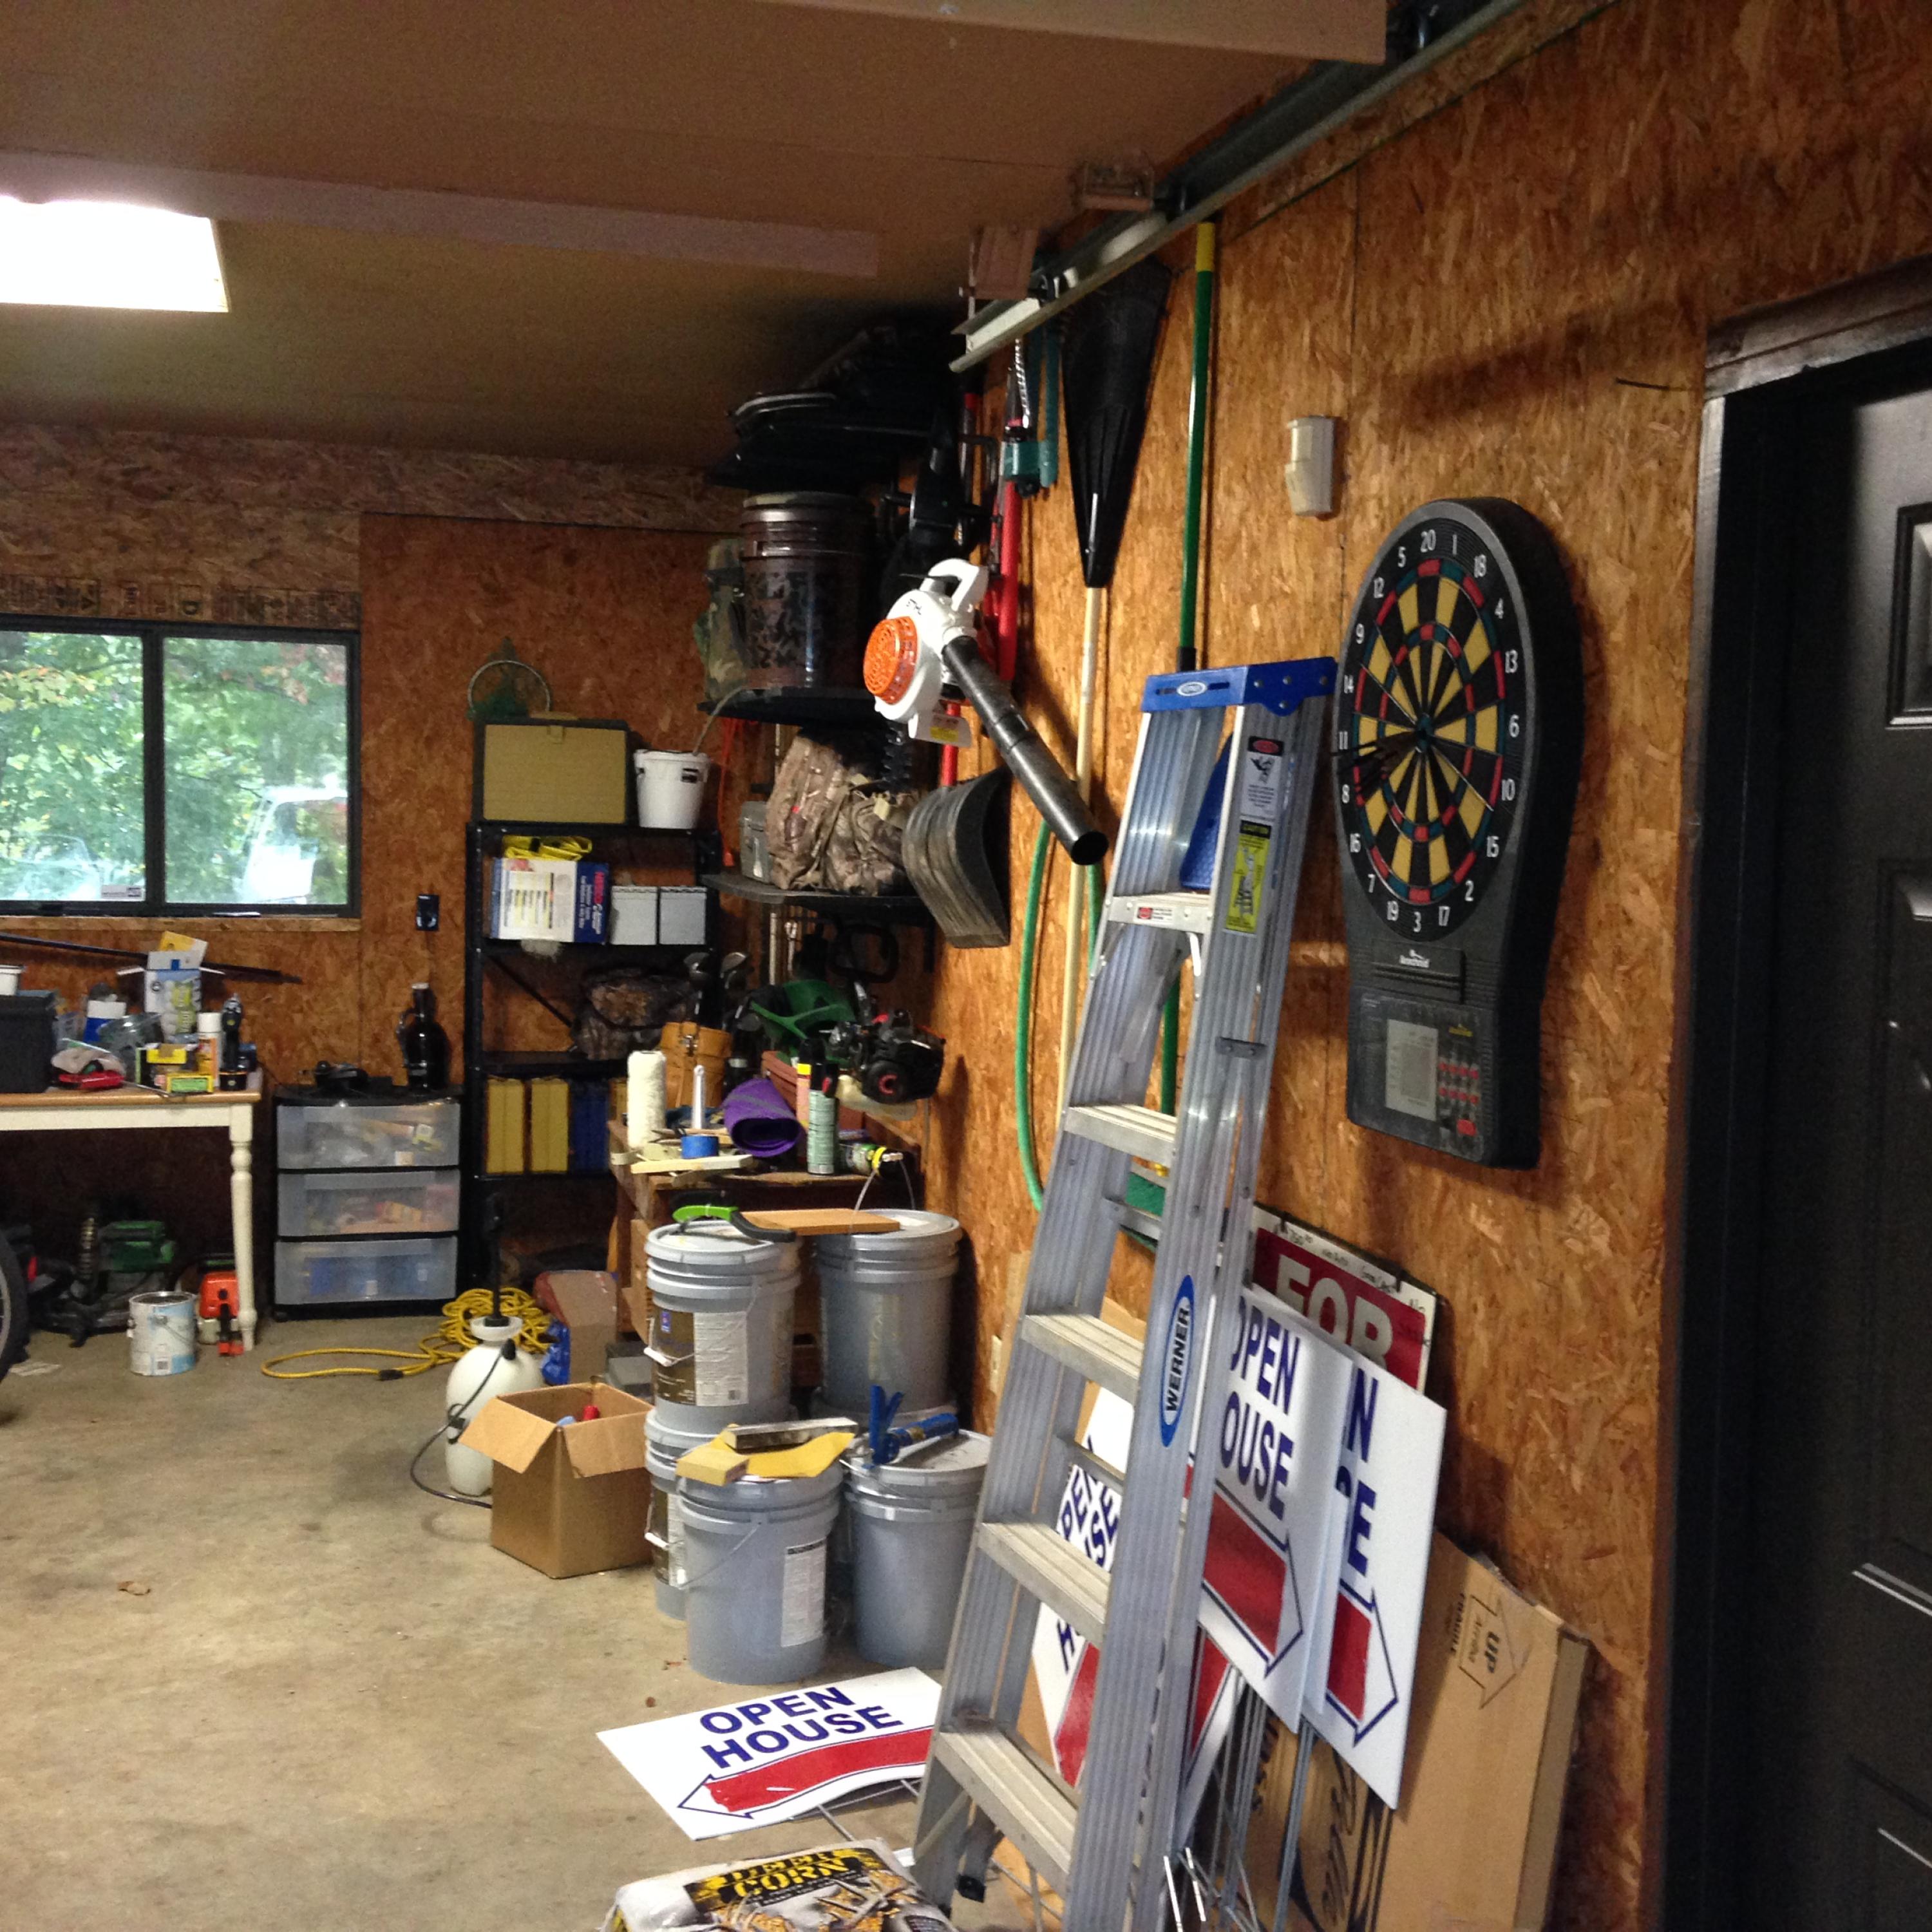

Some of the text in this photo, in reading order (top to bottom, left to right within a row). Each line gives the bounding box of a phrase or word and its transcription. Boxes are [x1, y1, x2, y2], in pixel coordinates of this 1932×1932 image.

[1421, 529, 1437, 553] 20
[1452, 535, 1457, 554] 1
[1397, 547, 1406, 567] 5
[1473, 554, 1487, 578] 18
[1374, 578, 1384, 598] 12
[1495, 599, 1504, 619] 4
[1356, 623, 1365, 643] 9
[1505, 649, 1518, 673] 13
[1343, 675, 1354, 694] 14
[1509, 715, 1520, 737] 6
[1339, 732, 1348, 750] 11
[1341, 784, 1350, 803] 8
[1501, 779, 1516, 800] 10
[1350, 833, 1361, 853] 16
[1486, 835, 1499, 857] 15
[1367, 874, 1376, 893] 7
[1465, 880, 1473, 902] 2
[1387, 902, 1399, 921] 19
[1438, 906, 1451, 926] 17
[1414, 912, 1421, 933] 3
[1166, 1308, 1189, 1412] WERNER
[1484, 1630, 1501, 1674] UP
[700, 1687, 856, 1734] OPEN
[701, 1706, 904, 1768] HOUSE
[734, 1858, 849, 1897] CORN
